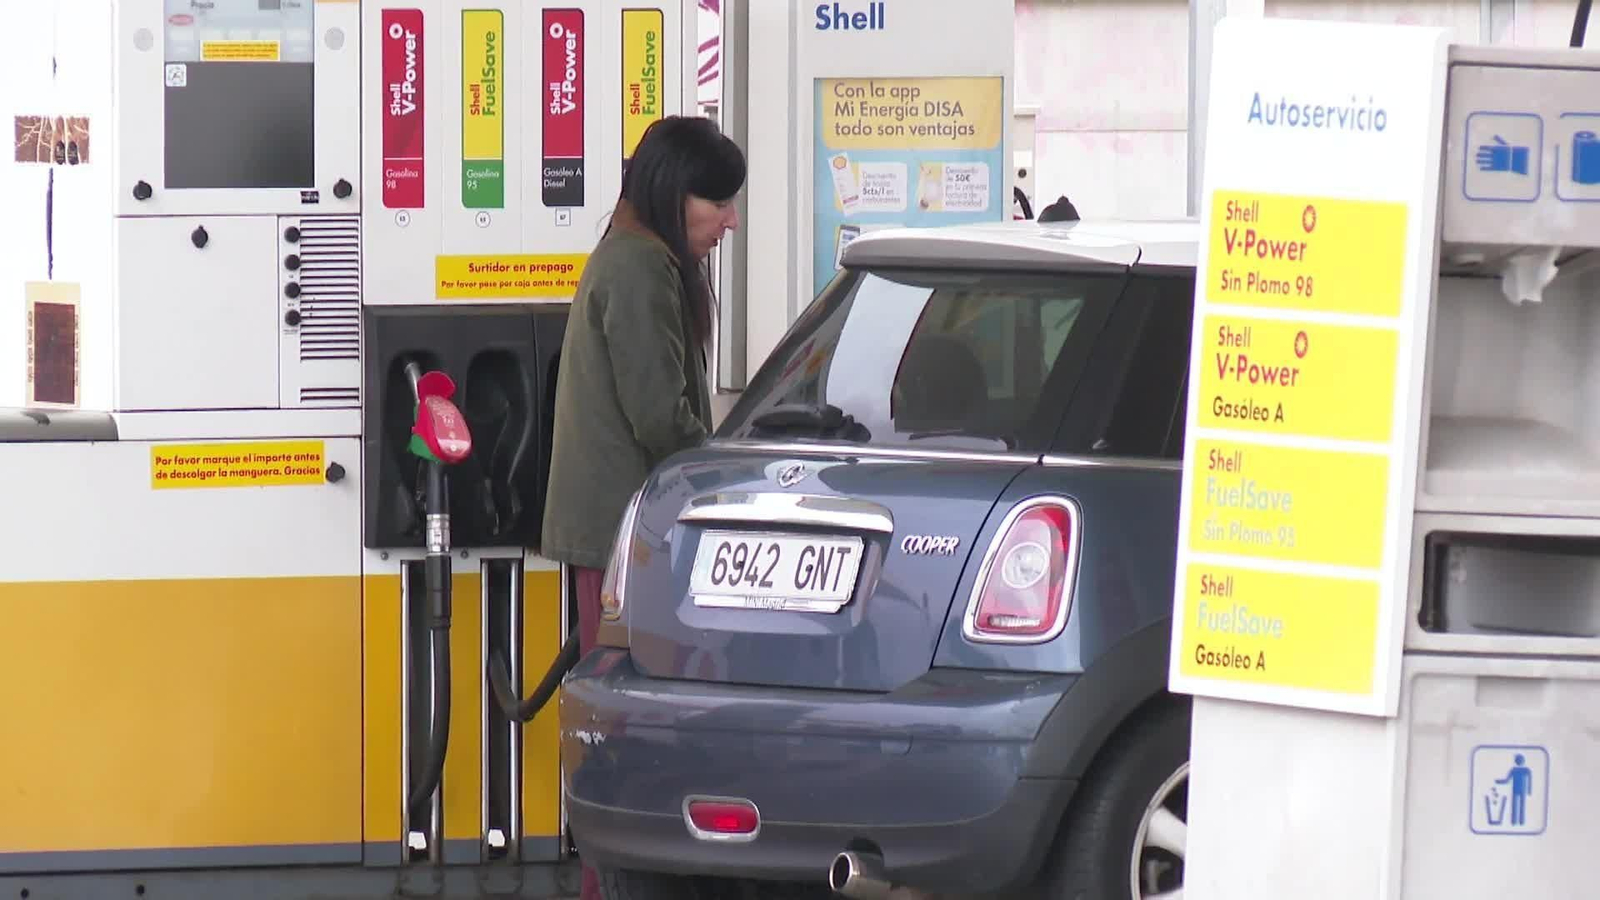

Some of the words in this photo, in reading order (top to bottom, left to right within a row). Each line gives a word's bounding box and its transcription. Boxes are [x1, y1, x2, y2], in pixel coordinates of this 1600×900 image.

[815, 2, 885, 30] Shell
[402, 30, 416, 115] V-Power
[482, 31, 496, 116] FuelSave
[562, 29, 577, 114] V-Power
[642, 30, 656, 115] FuelSave
[390, 84, 401, 115] Shell
[470, 84, 481, 116] Shell
[550, 83, 561, 115] Shell
[630, 83, 641, 116] Shell
[834, 82, 865, 98] Con
[870, 81, 886, 98] la
[890, 86, 920, 102] app
[834, 101, 855, 117] Mi
[860, 101, 919, 121] Energía
[924, 101, 964, 117] DISA
[1248, 92, 1387, 132] Autoservicio
[835, 120, 872, 136] todo
[877, 124, 904, 136] son
[909, 121, 975, 140] ventajas
[386, 167, 418, 178] Gasolina
[386, 179, 397, 189] 98
[466, 168, 500, 179] Gasolina
[467, 180, 478, 190] 95
[543, 178, 566, 187] Diesel
[575, 167, 583, 176] A
[1226, 200, 1259, 223] Shell
[1224, 227, 1307, 262] V-Power
[468, 262, 510, 273] Surtidor
[513, 263, 526, 272] en
[529, 262, 574, 274] prepago
[441, 280, 454, 288] Por
[456, 279, 477, 289] favor
[499, 281, 512, 289] por
[514, 280, 531, 289] caja
[555, 279, 565, 287] de
[567, 280, 580, 288] rep
[1221, 269, 1241, 291] Sin
[1247, 271, 1290, 295] Plomo
[1296, 276, 1313, 297] 98
[1218, 326, 1251, 348] Shell
[1216, 353, 1300, 387] V-Power
[1212, 396, 1269, 421] Gasóleo
[1274, 402, 1284, 423] A
[155, 456, 172, 466] Por
[174, 455, 200, 466] favor
[202, 455, 241, 466] marque
[243, 453, 252, 463] el
[253, 453, 291, 465] importe
[293, 453, 320, 462] antes
[155, 470, 168, 479] de
[170, 468, 216, 480] descolgar
[218, 468, 227, 477] la
[229, 468, 282, 480] manguera.
[284, 465, 320, 475] Gracias
[1208, 449, 1242, 473] Shell
[1206, 477, 1292, 513] FuelSave
[901, 535, 960, 555] COOPER
[1203, 519, 1225, 541] Sin
[1230, 521, 1273, 546] Plomo
[1277, 526, 1295, 548] 95
[711, 541, 781, 588] 6942
[794, 545, 851, 592] GNT
[1200, 574, 1233, 598] Shell
[1198, 602, 1284, 638] FuelSave
[1195, 644, 1251, 670] Gasóleo
[1256, 650, 1266, 672] A
